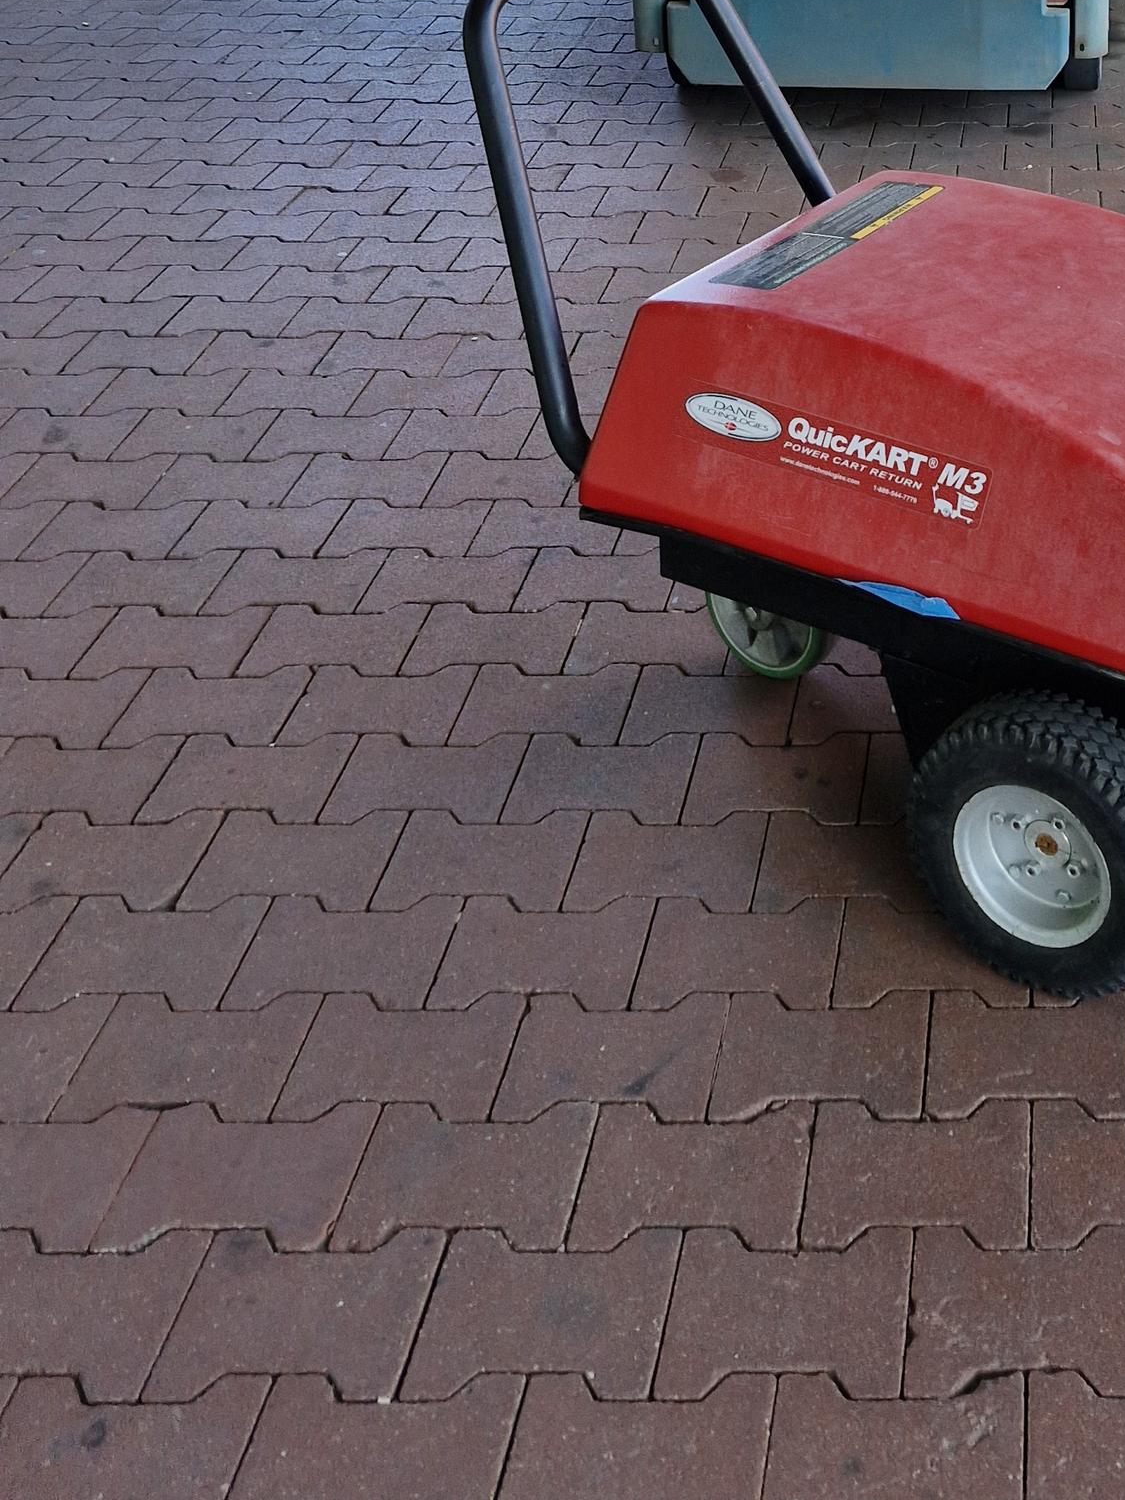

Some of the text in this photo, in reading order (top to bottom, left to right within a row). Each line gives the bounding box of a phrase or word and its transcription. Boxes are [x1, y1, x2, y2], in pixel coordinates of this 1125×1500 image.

[697, 404, 770, 432] TECHNOLOGIES
[714, 400, 758, 421] DANE
[783, 441, 923, 491] POWER CART RETURN
[937, 462, 988, 495] M3
